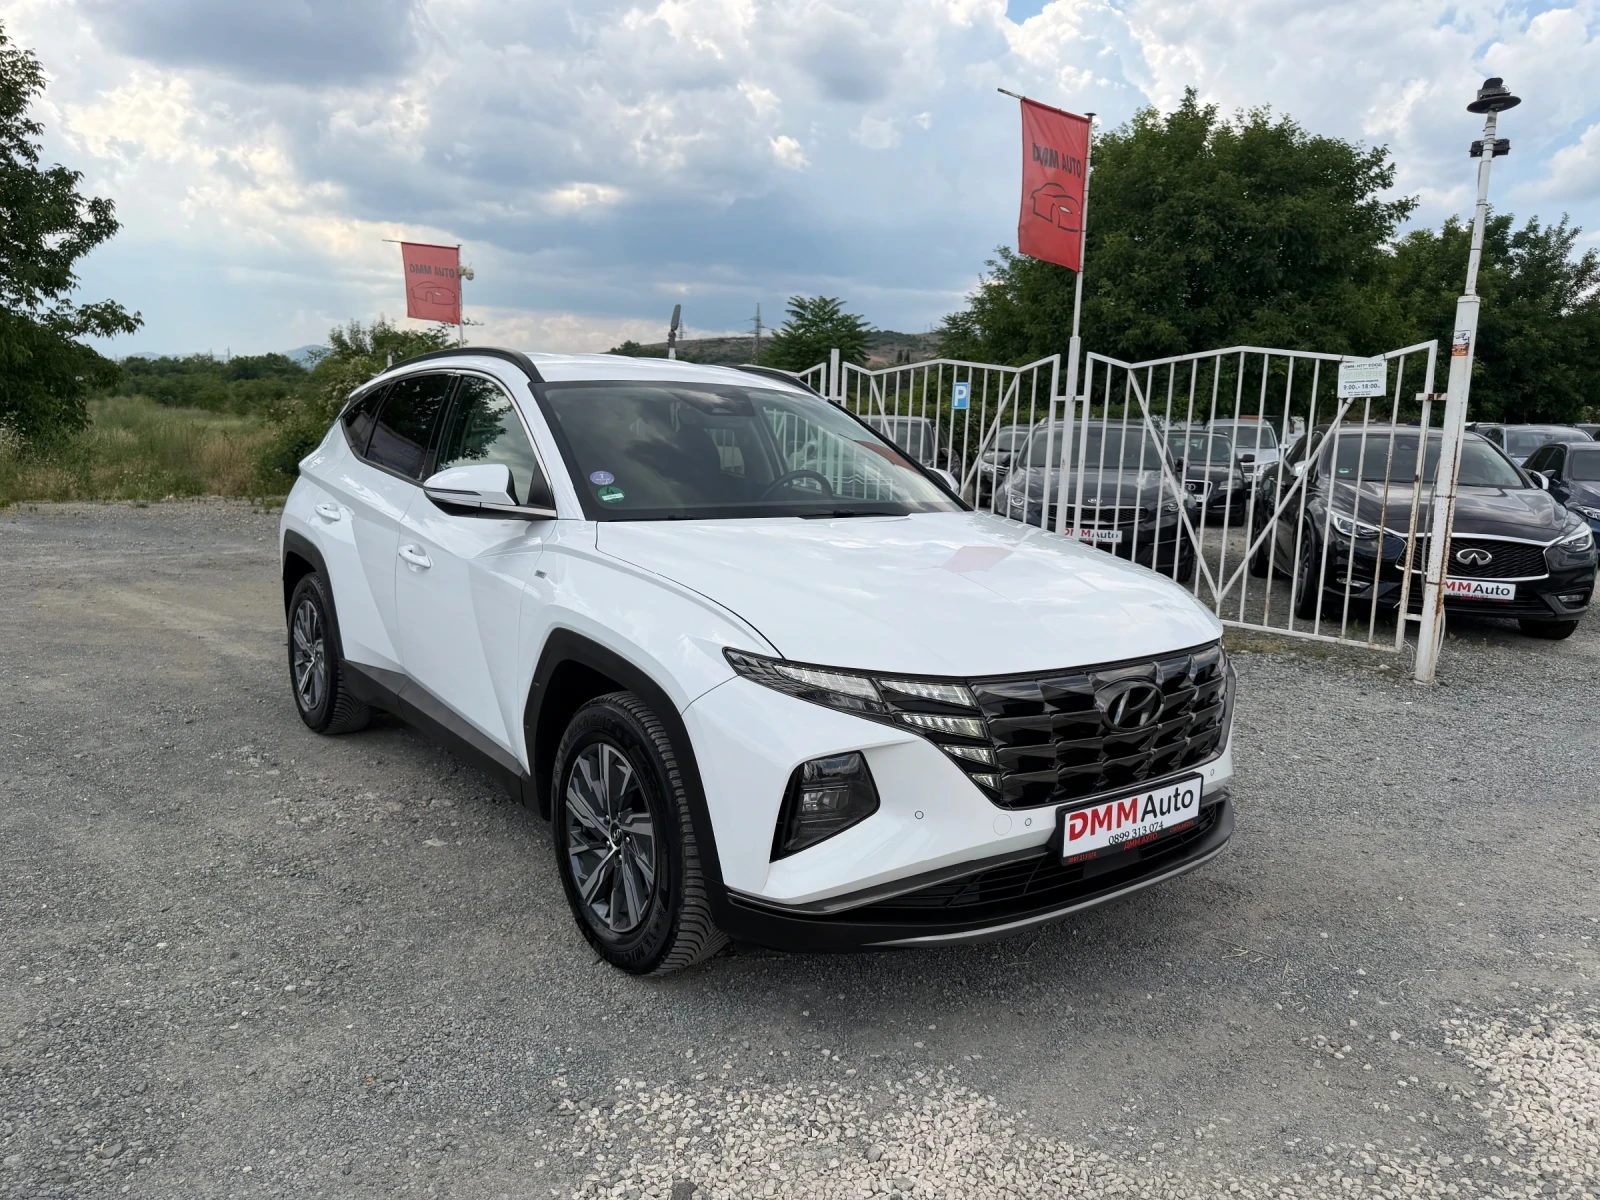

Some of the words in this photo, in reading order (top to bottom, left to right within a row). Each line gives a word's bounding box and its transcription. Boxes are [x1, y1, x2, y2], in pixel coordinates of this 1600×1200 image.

[1032, 142, 1059, 169] DMM
[1062, 152, 1081, 178] AUTO
[409, 263, 432, 274] DMM
[434, 265, 454, 278] AUTO
[954, 386, 967, 406] P
[1108, 830, 1130, 845] 0899
[1132, 825, 1148, 839] 313
[1149, 820, 1164, 834] 074
